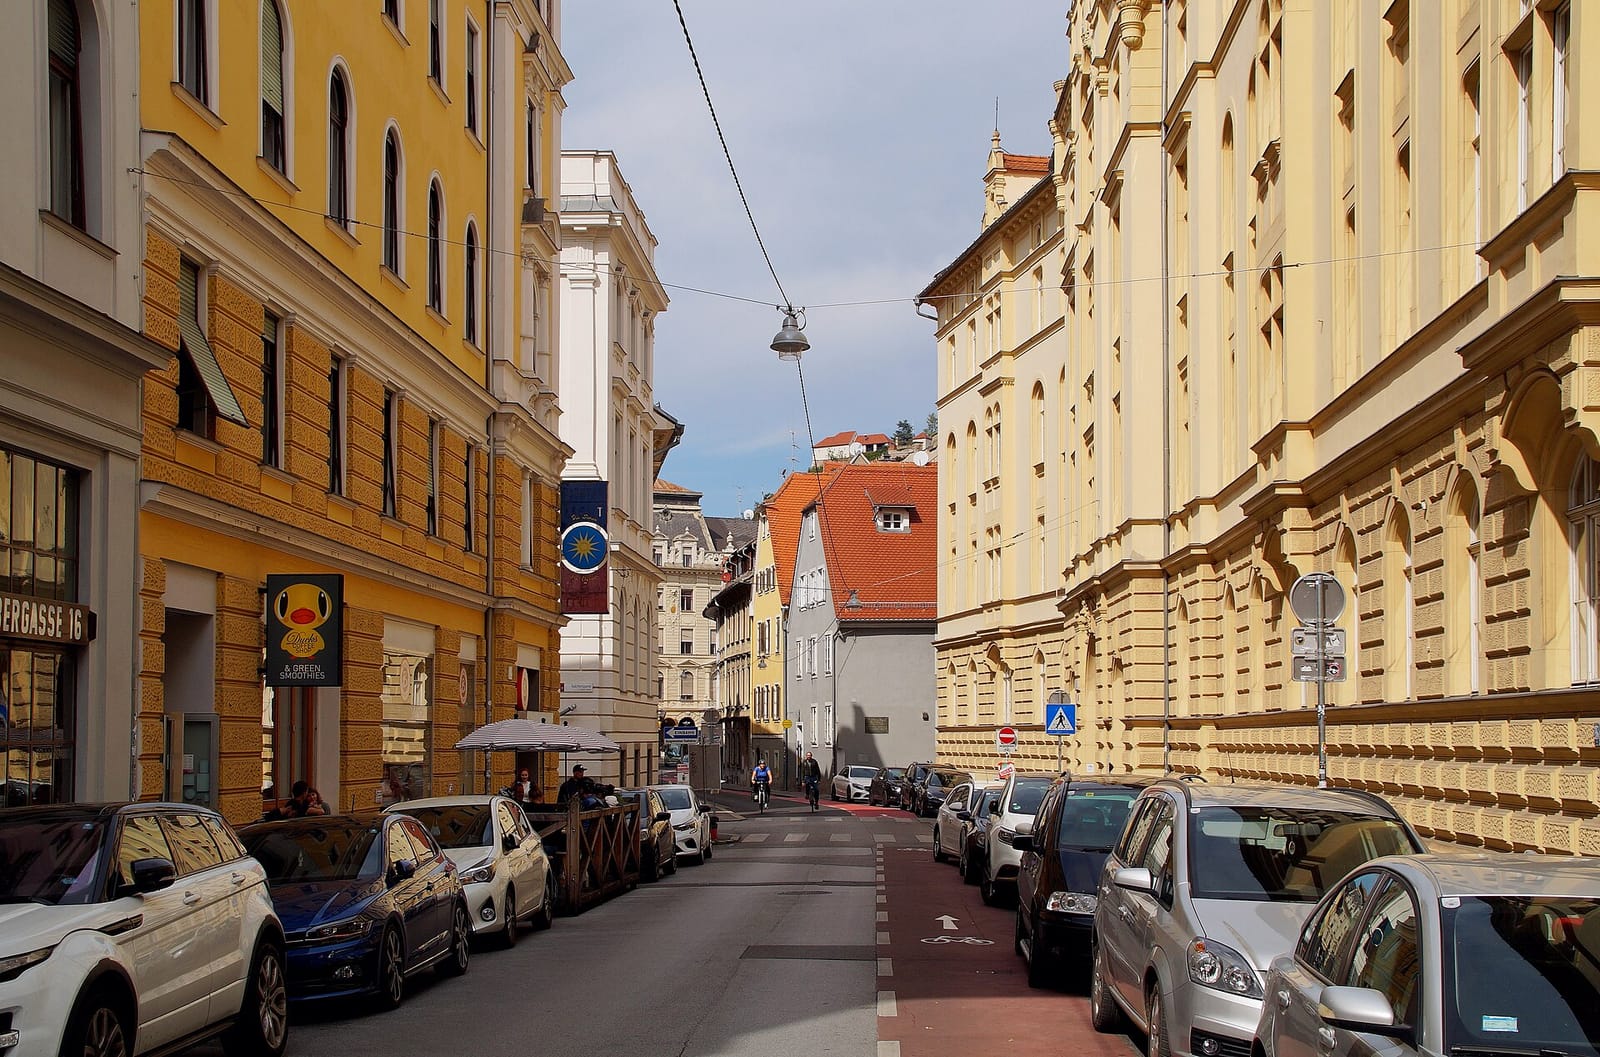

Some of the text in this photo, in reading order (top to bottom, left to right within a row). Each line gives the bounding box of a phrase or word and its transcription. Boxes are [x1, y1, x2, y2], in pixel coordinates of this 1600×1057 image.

[0, 597, 82, 640] ERGASSE 16
[284, 664, 321, 672] & GREEN
[279, 671, 326, 680] SMOOTHIES
